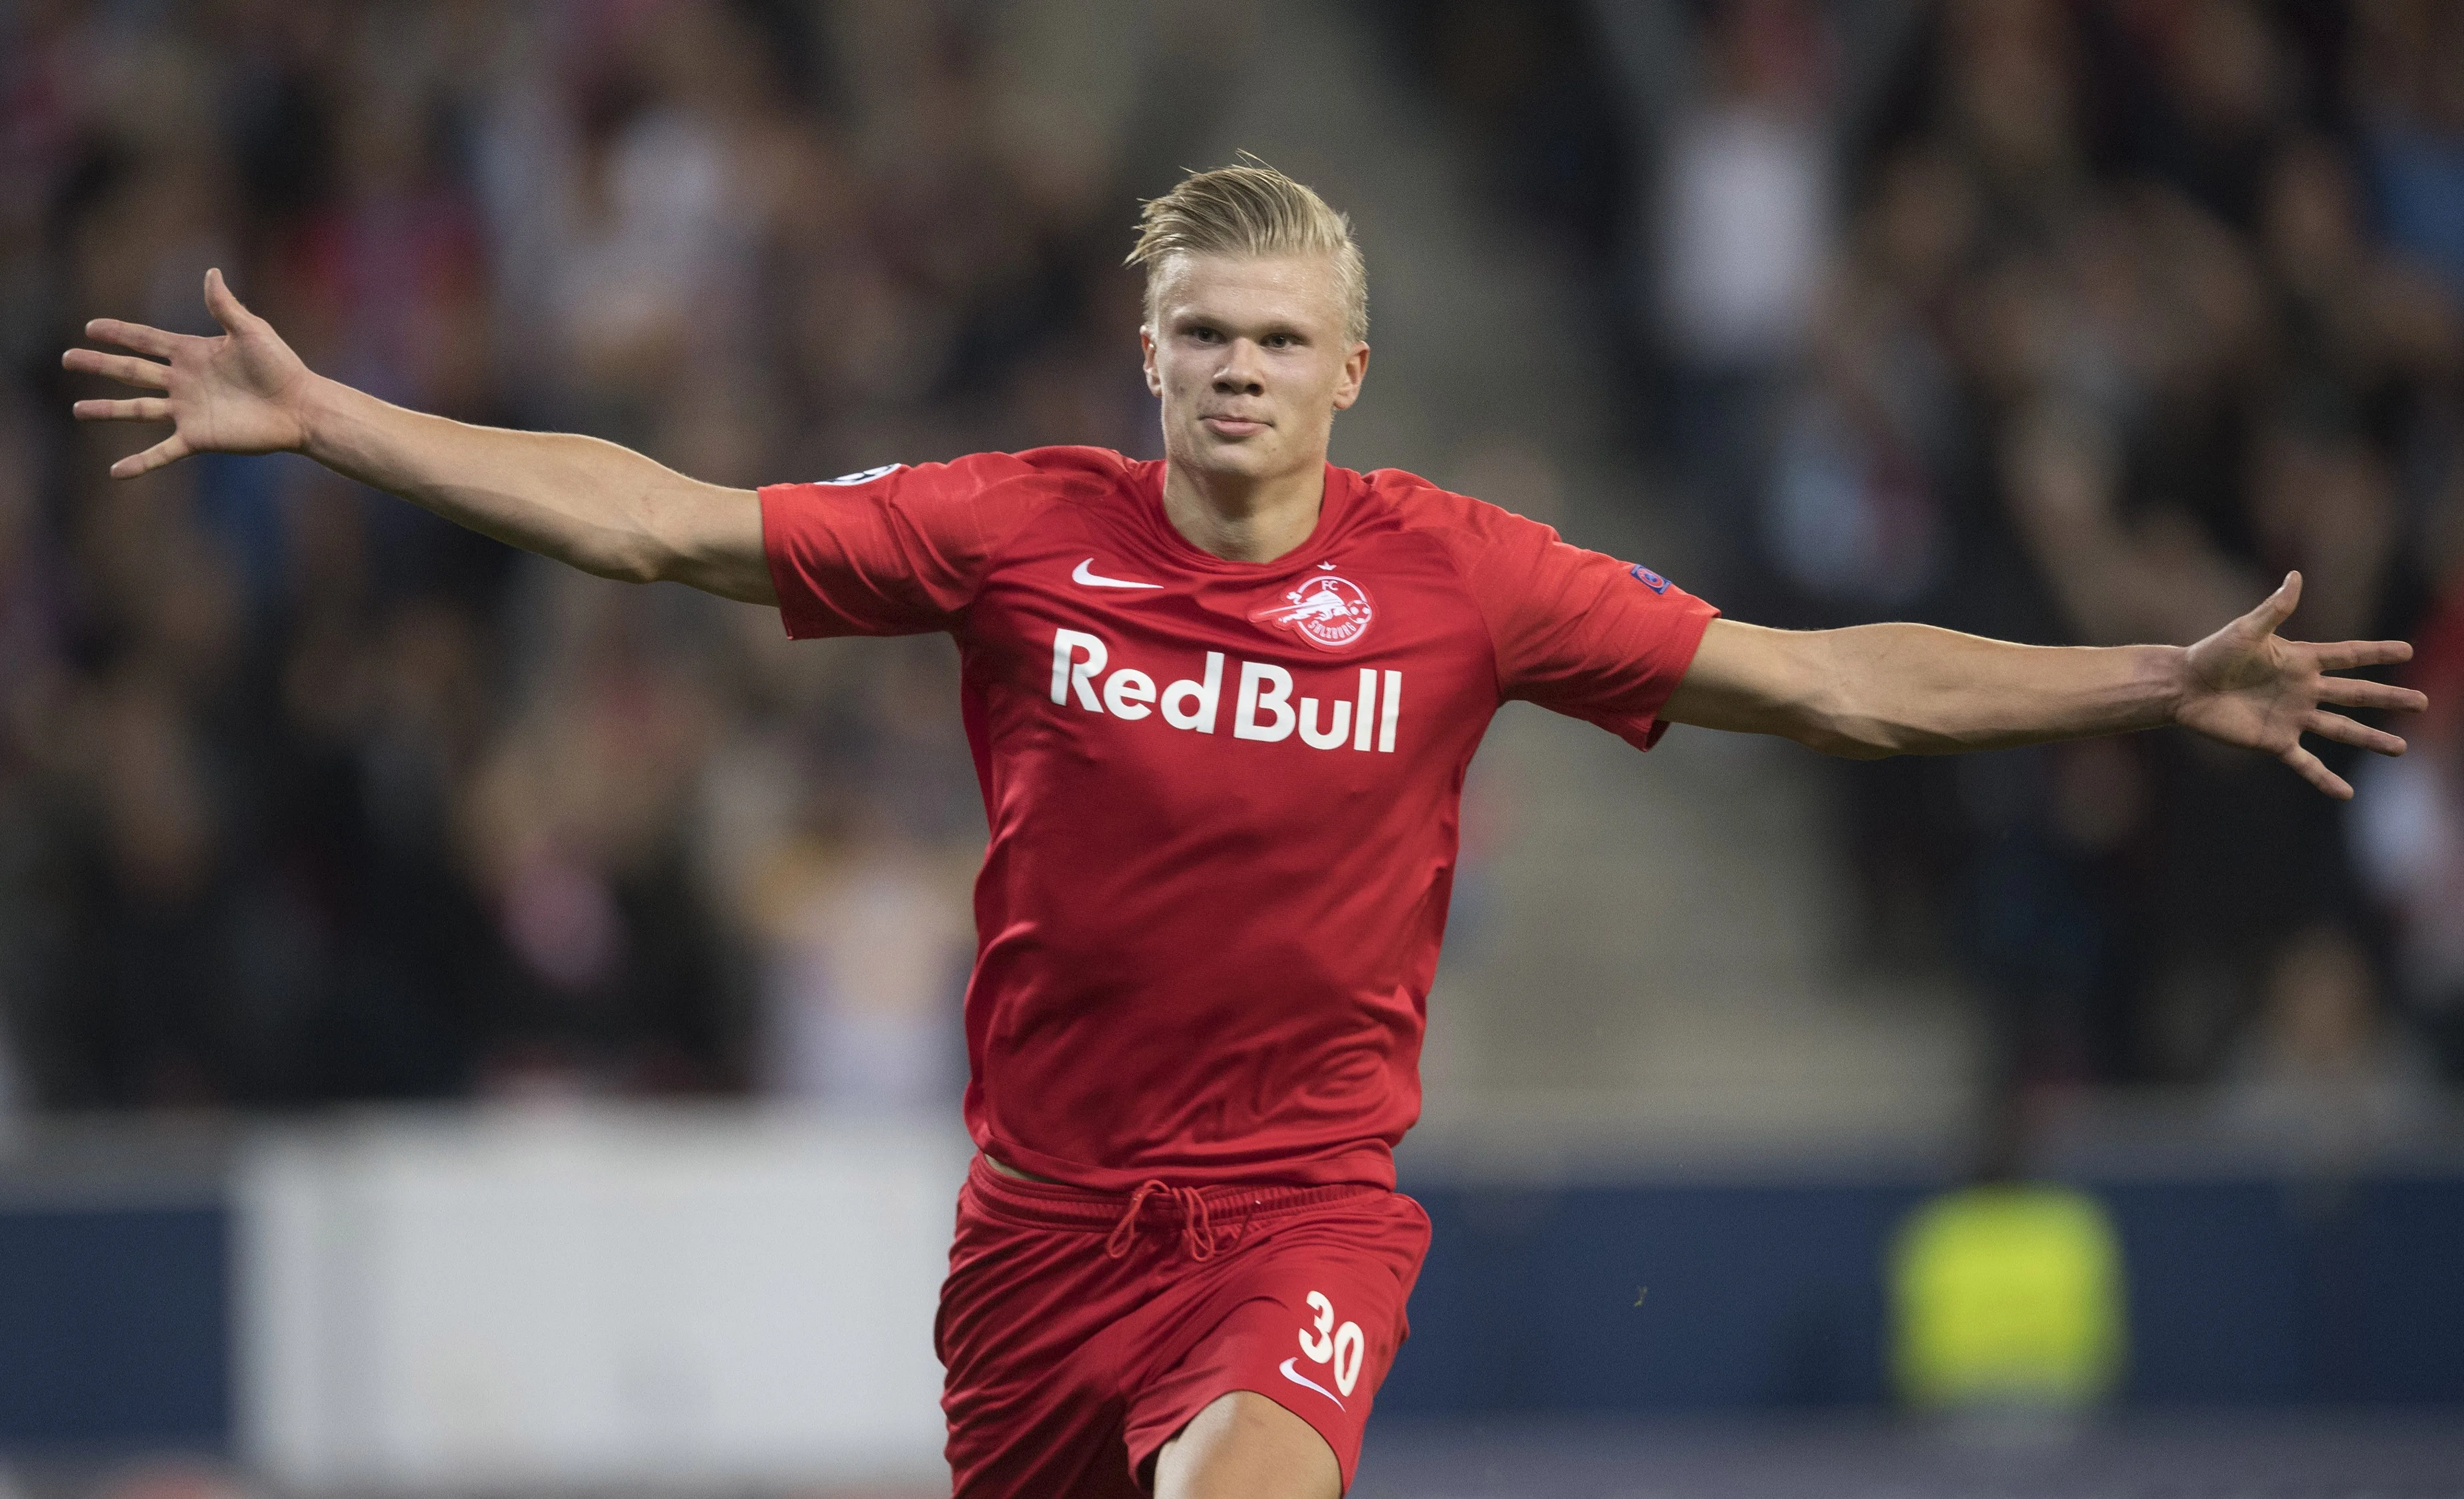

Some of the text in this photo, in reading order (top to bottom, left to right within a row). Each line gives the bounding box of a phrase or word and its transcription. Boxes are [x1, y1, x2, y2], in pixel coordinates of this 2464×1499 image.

[1321, 580, 1338, 591] FC
[1050, 627, 1403, 753] Red Bull
[1298, 1290, 1365, 1397] 30
